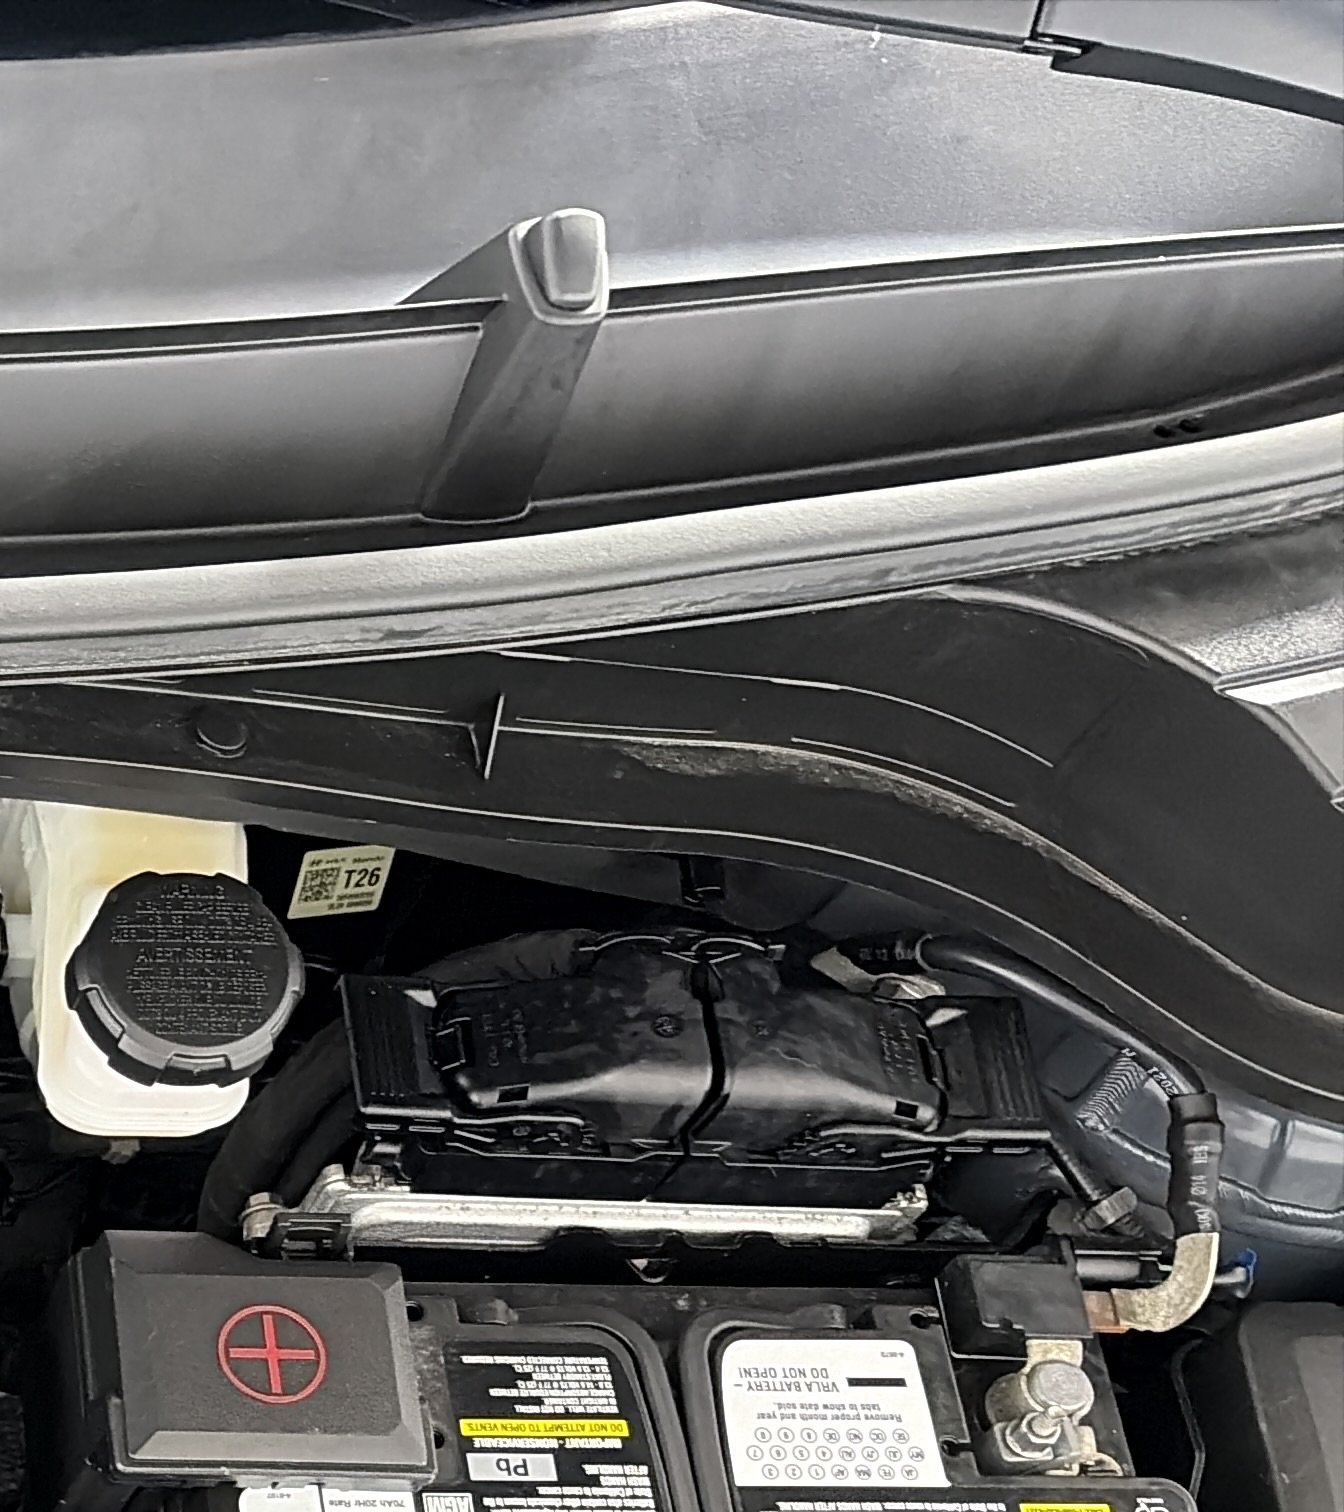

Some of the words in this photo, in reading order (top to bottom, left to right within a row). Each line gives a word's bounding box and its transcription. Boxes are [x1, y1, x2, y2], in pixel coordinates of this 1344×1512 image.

[344, 867, 381, 888] T26
[738, 1367, 776, 1378] OPEN!
[782, 1368, 805, 1378] NOT
[812, 1368, 828, 1378] DO
[747, 1381, 800, 1392] BATTERY
[805, 1381, 839, 1392] VRLA
[773, 1403, 796, 1411] sold.
[799, 1403, 819, 1411] date
[822, 1403, 846, 1411] show
[860, 1404, 880, 1412] tabs
[757, 1411, 777, 1420] year
[780, 1413, 796, 1421] and
[799, 1413, 828, 1421] month
[831, 1411, 861, 1421] proper
[864, 1413, 902, 1422] Remove
[464, 1422, 498, 1432] VENTS.
[500, 1423, 526, 1432] OPEN
[527, 1423, 540, 1432] TO
[543, 1423, 586, 1432] ATTEMPT
[588, 1423, 608, 1432] NOT
[610, 1423, 623, 1432] DO
[495, 1458, 529, 1476] Pb
[380, 1499, 405, 1507] 70Ah
